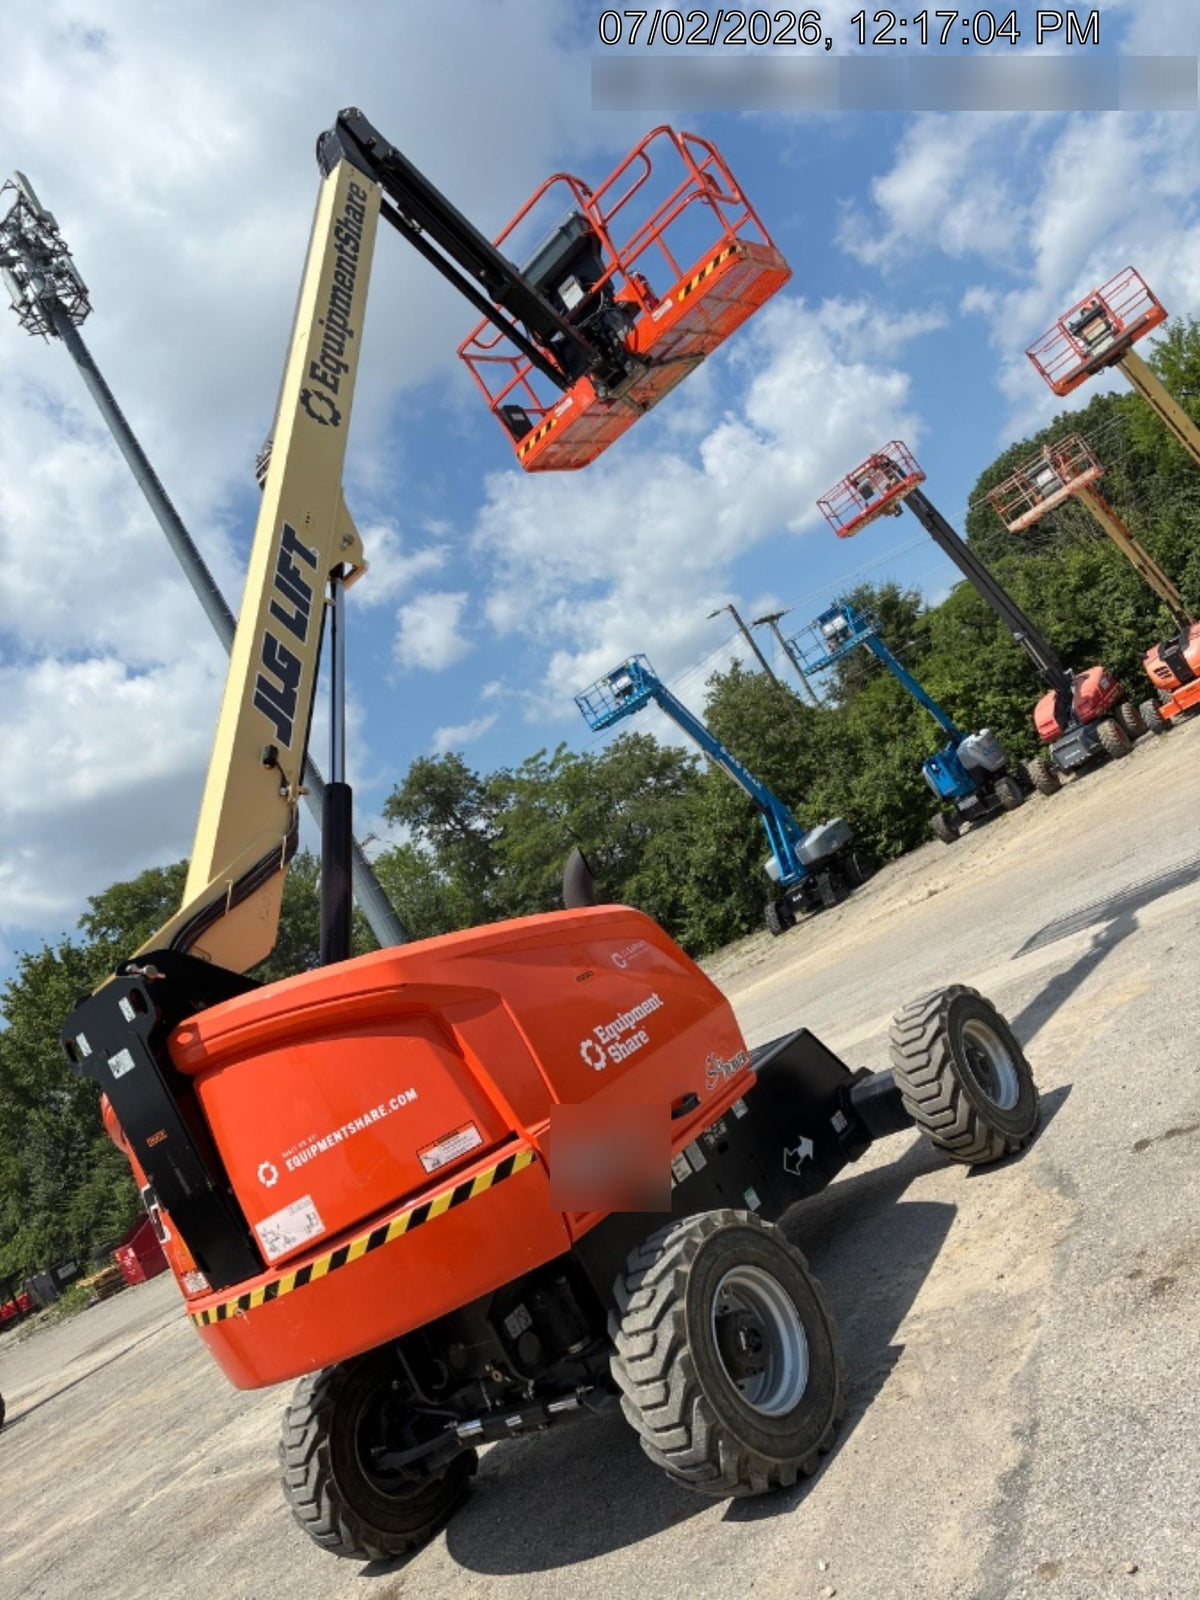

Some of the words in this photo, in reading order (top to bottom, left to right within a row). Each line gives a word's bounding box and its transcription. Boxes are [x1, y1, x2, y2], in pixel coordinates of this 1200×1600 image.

[308, 181, 368, 395] EquipmentShare
[268, 520, 319, 646] LIFT
[253, 628, 303, 749] JLG
[592, 991, 665, 1045] Equipment
[606, 1029, 651, 1065] Share
[284, 1087, 419, 1173] EQUIPMENTSHARE.COM
